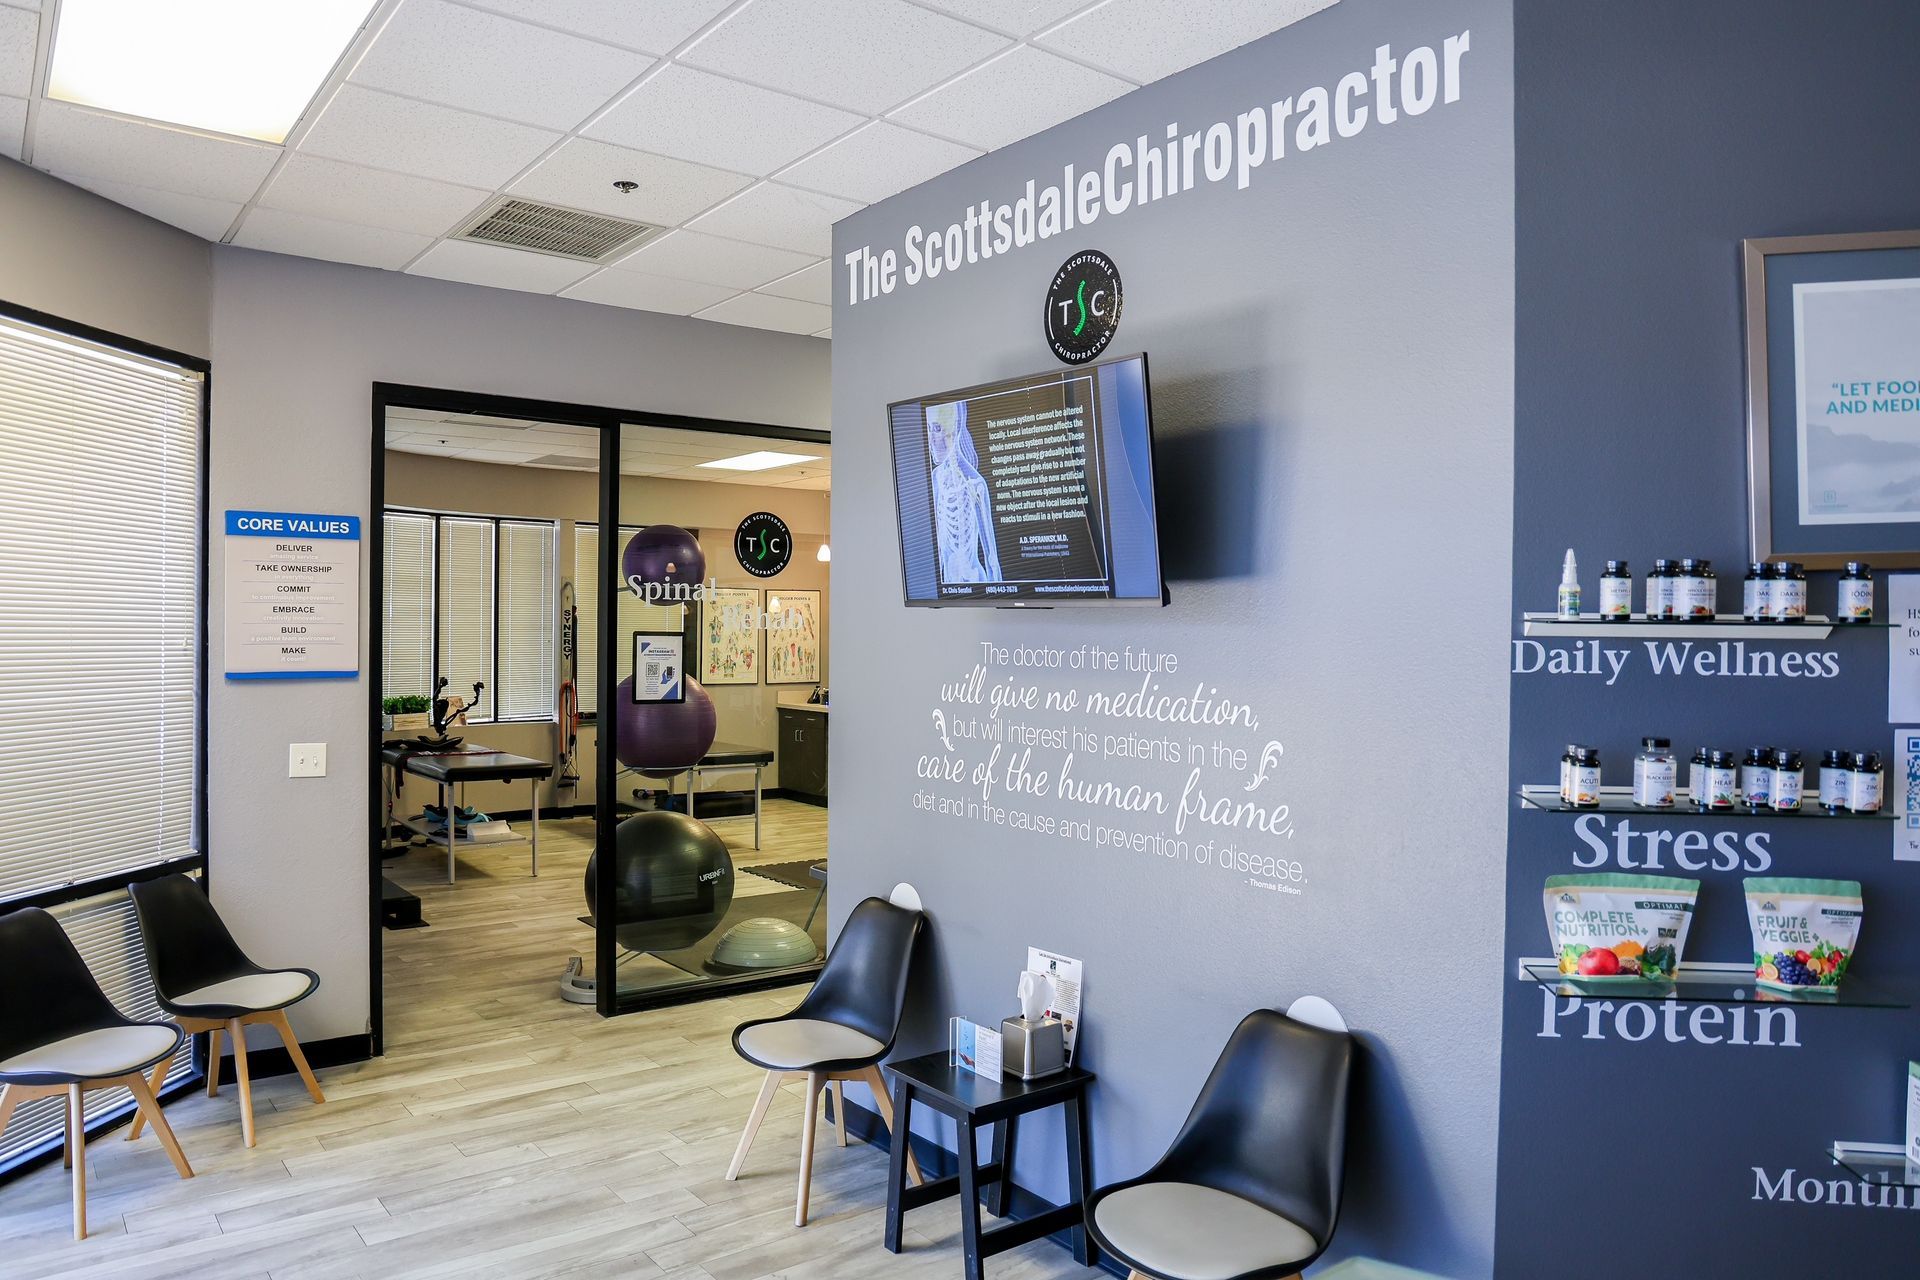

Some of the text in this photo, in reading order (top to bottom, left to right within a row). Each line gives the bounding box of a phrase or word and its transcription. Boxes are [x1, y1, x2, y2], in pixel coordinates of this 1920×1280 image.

[845, 245, 898, 306] The
[1053, 255, 1113, 290] THE SCOTTSDALE
[1055, 330, 1111, 360] CHIROPRACTOR
[1877, 380, 1920, 396] FOO
[987, 405, 1083, 428] The nervous system cannot be altered
[1826, 398, 1920, 415] AND MEDI
[1007, 428, 1020, 438] Local
[1022, 425, 1053, 436] interference
[1054, 421, 1073, 431] affects
[1073, 418, 1083, 428] the
[989, 443, 1004, 452] whole
[1004, 441, 1025, 450] nervous
[1025, 438, 1043, 448] system
[1068, 432, 1085, 441] These
[991, 454, 1012, 464] changes
[1013, 453, 1025, 463] pass
[1039, 447, 1065, 459] gradually
[1065, 446, 1075, 454] but
[1076, 444, 1085, 453] not
[1020, 464, 1030, 473] and
[1031, 463, 1042, 473] give
[1042, 461, 1052, 470] rise
[1064, 458, 1086, 468] number
[1002, 476, 1032, 488] adaptations
[1039, 474, 1048, 483] the
[1049, 474, 1060, 482] new
[1060, 470, 1084, 481] artificial
[1012, 489, 1021, 498] The
[1022, 488, 1042, 497] nervous
[1043, 486, 1062, 497] system
[1069, 484, 1080, 493] now
[1007, 502, 1023, 512] object
[1023, 501, 1036, 510] after
[1036, 499, 1045, 508] the
[1046, 497, 1059, 507] local
[1059, 497, 1076, 506] lesion
[1077, 495, 1088, 505] and
[237, 517, 350, 534] CORE VALUES
[1000, 514, 1016, 524] reacts
[1023, 512, 1040, 521] stimuli
[1052, 511, 1063, 520] new
[276, 544, 313, 552] DELIVER
[255, 564, 332, 573] TAKE OWNERSHIP
[628, 574, 717, 608] Spinal
[281, 626, 306, 634] BUILD
[563, 609, 572, 660] SYNERGY
[980, 641, 1178, 674] The doctor of the future
[1511, 639, 1840, 686] Daily Wellness
[941, 663, 1260, 732] will give no medication,
[953, 714, 1248, 771] but will interest his patients in the
[917, 743, 1295, 840] care of the human frame,
[913, 789, 1309, 884] diet and in the cause and prevention of disease.
[1572, 813, 1772, 872] Stress
[1250, 878, 1302, 896] Thomas Edison
[1554, 910, 1635, 924] COMPLETE
[1757, 916, 1808, 929] FRUIT &
[1536, 984, 1802, 1047] Protein
